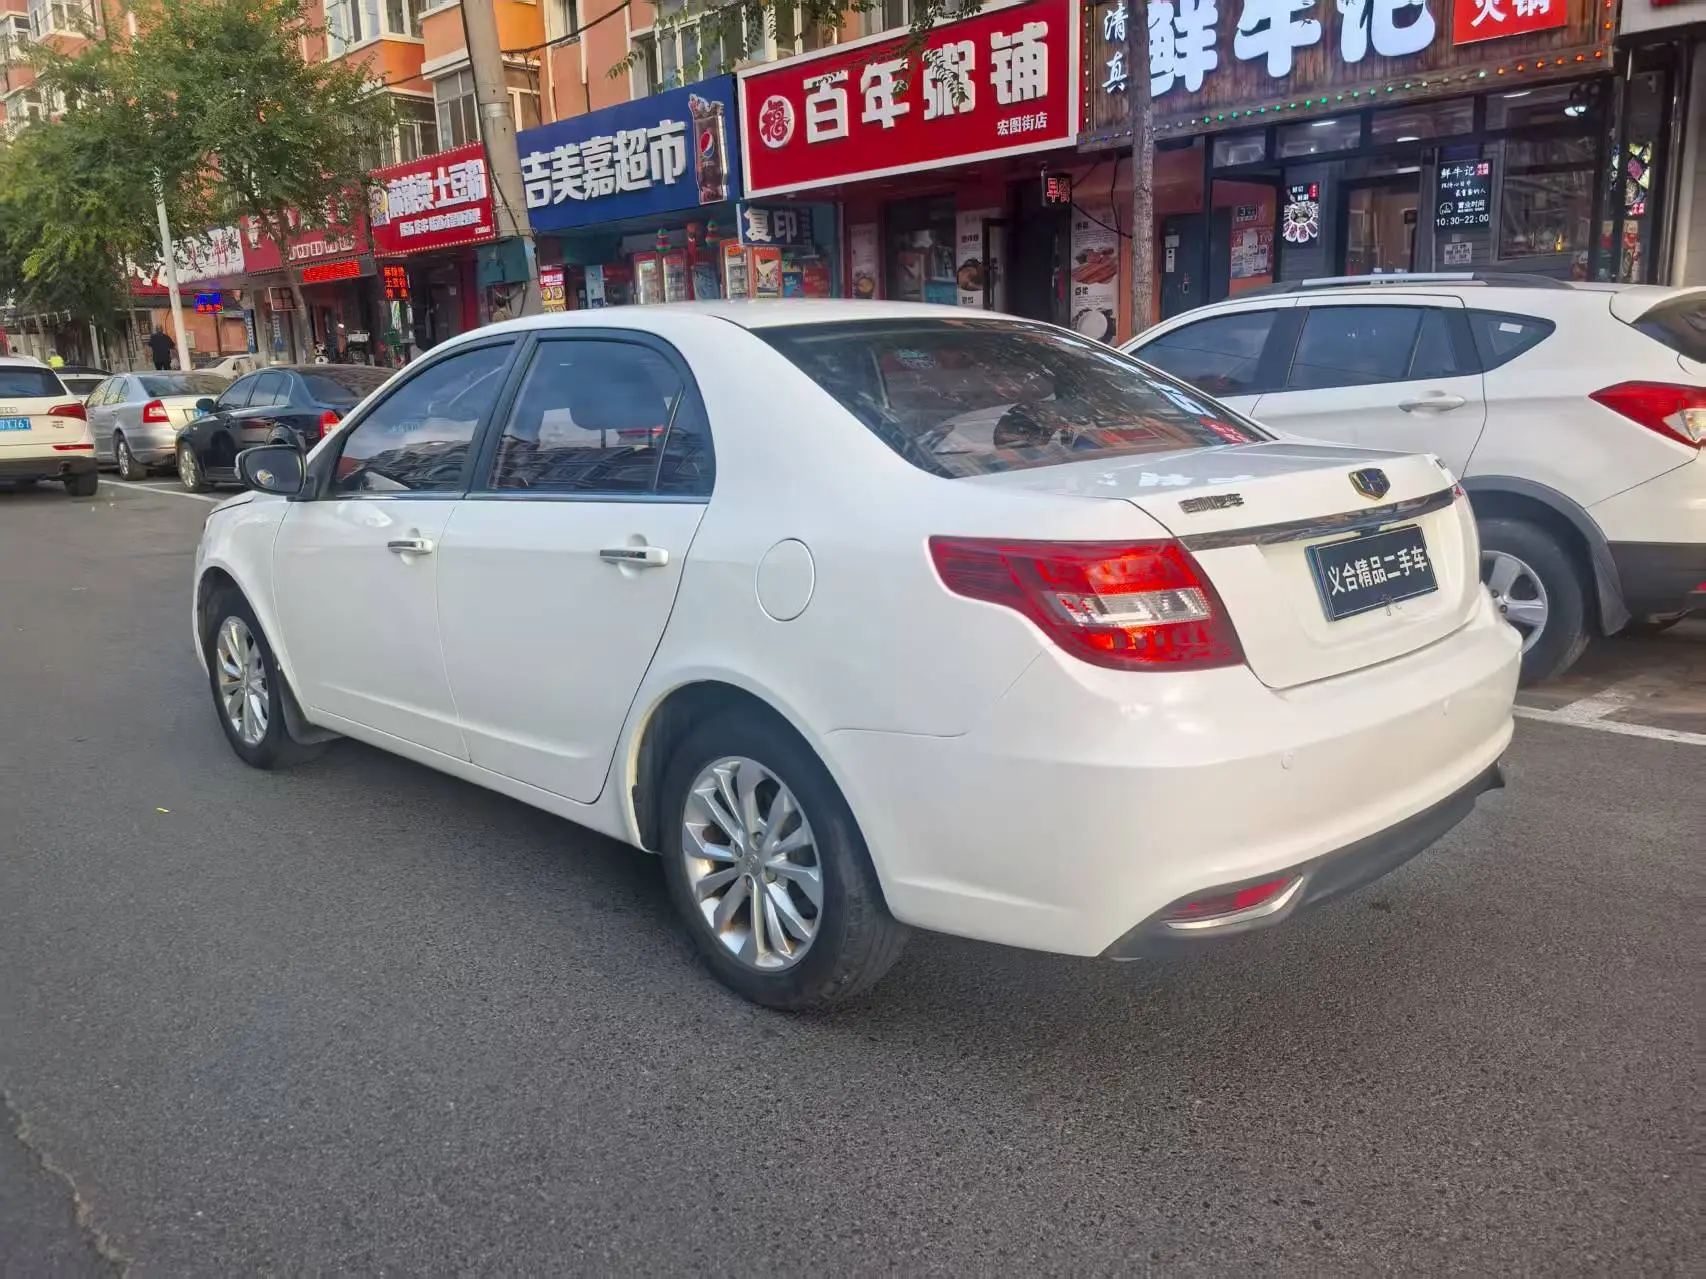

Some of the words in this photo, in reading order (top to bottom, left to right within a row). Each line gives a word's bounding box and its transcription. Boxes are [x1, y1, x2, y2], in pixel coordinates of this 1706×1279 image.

[1102, 1, 1128, 93] 清真
[1147, 0, 1434, 94] 鲜牛记
[803, 21, 1048, 144] 百年粥铺
[997, 111, 1048, 136] 宏图街店
[520, 119, 687, 208] 吉美嘉超市
[1440, 165, 1475, 179] 鲜牛记
[743, 207, 798, 244] 复印
[1436, 214, 1489, 227] 10:30-22:00
[1457, 200, 1485, 209] 营业时间
[1327, 545, 1428, 596] 义合精品二手车
